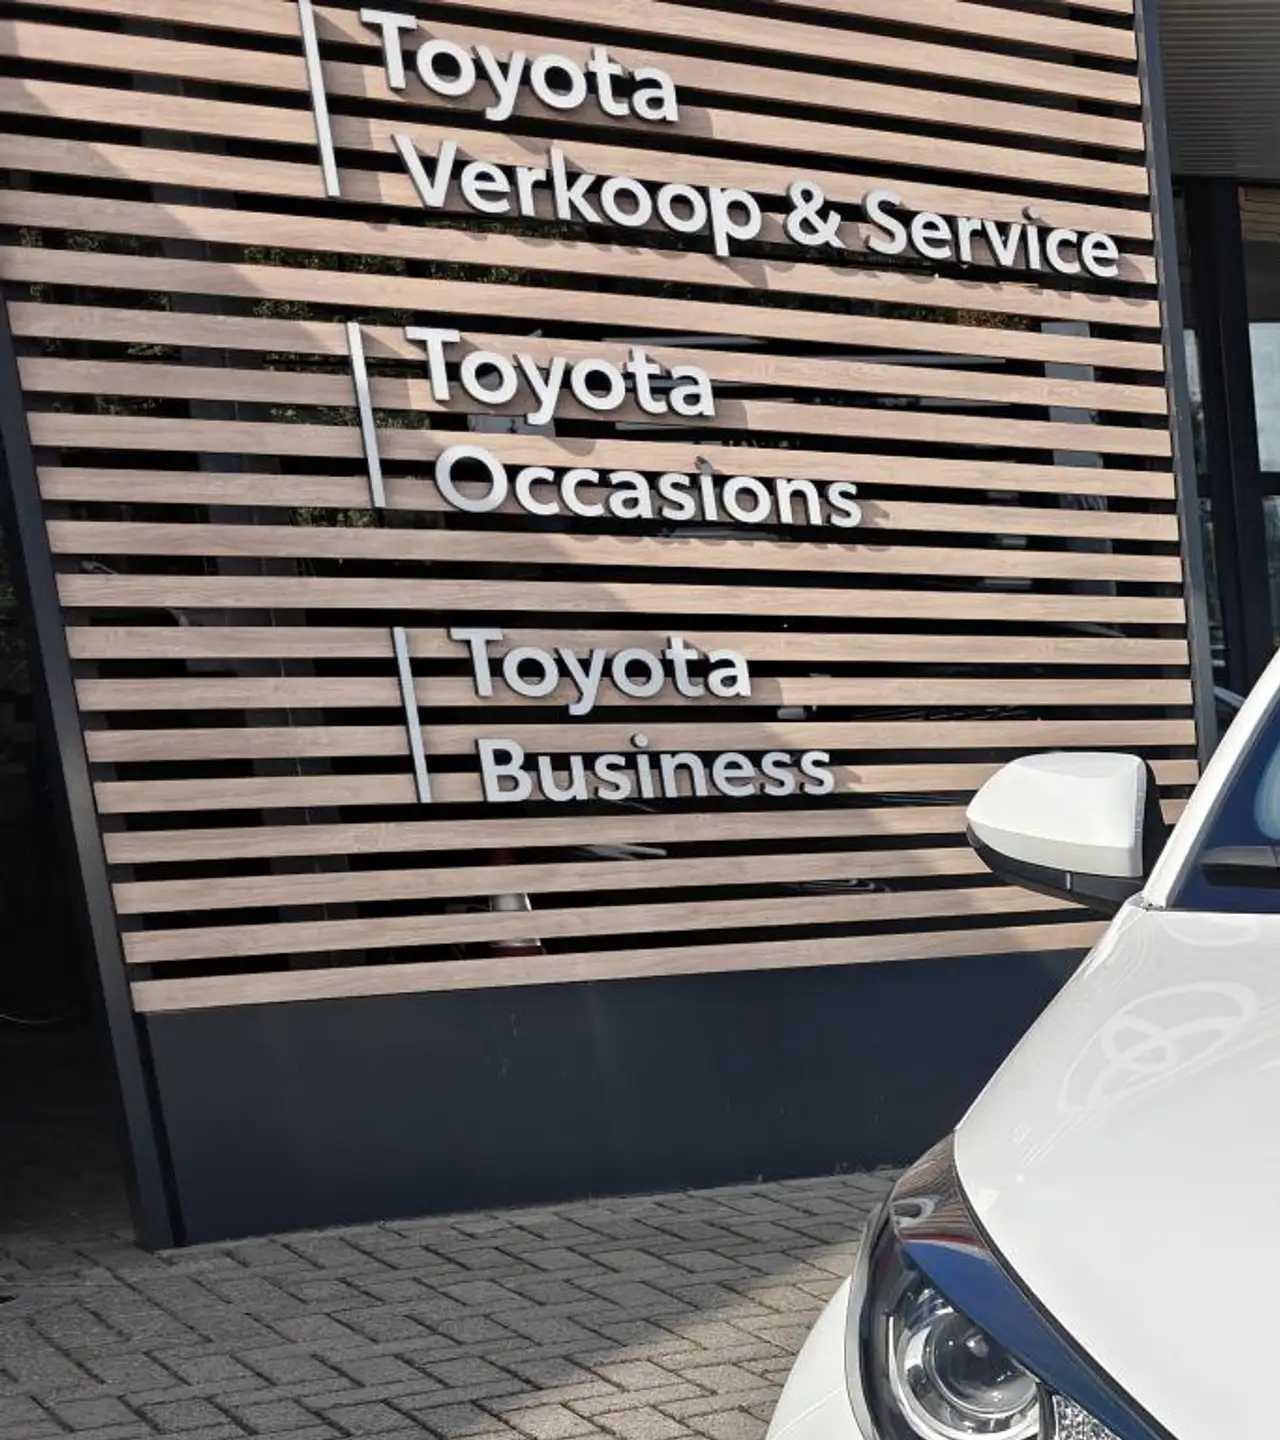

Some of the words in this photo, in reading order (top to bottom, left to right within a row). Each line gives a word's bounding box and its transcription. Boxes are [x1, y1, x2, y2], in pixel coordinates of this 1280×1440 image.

[360, 8, 679, 122] Toyota
[393, 133, 762, 257] Verkoop
[784, 180, 846, 250] &
[862, 187, 1120, 277] Service
[405, 325, 716, 425] Toyota
[434, 444, 863, 528] Occasions
[447, 627, 752, 715] Toyota
[474, 732, 837, 802] Business
